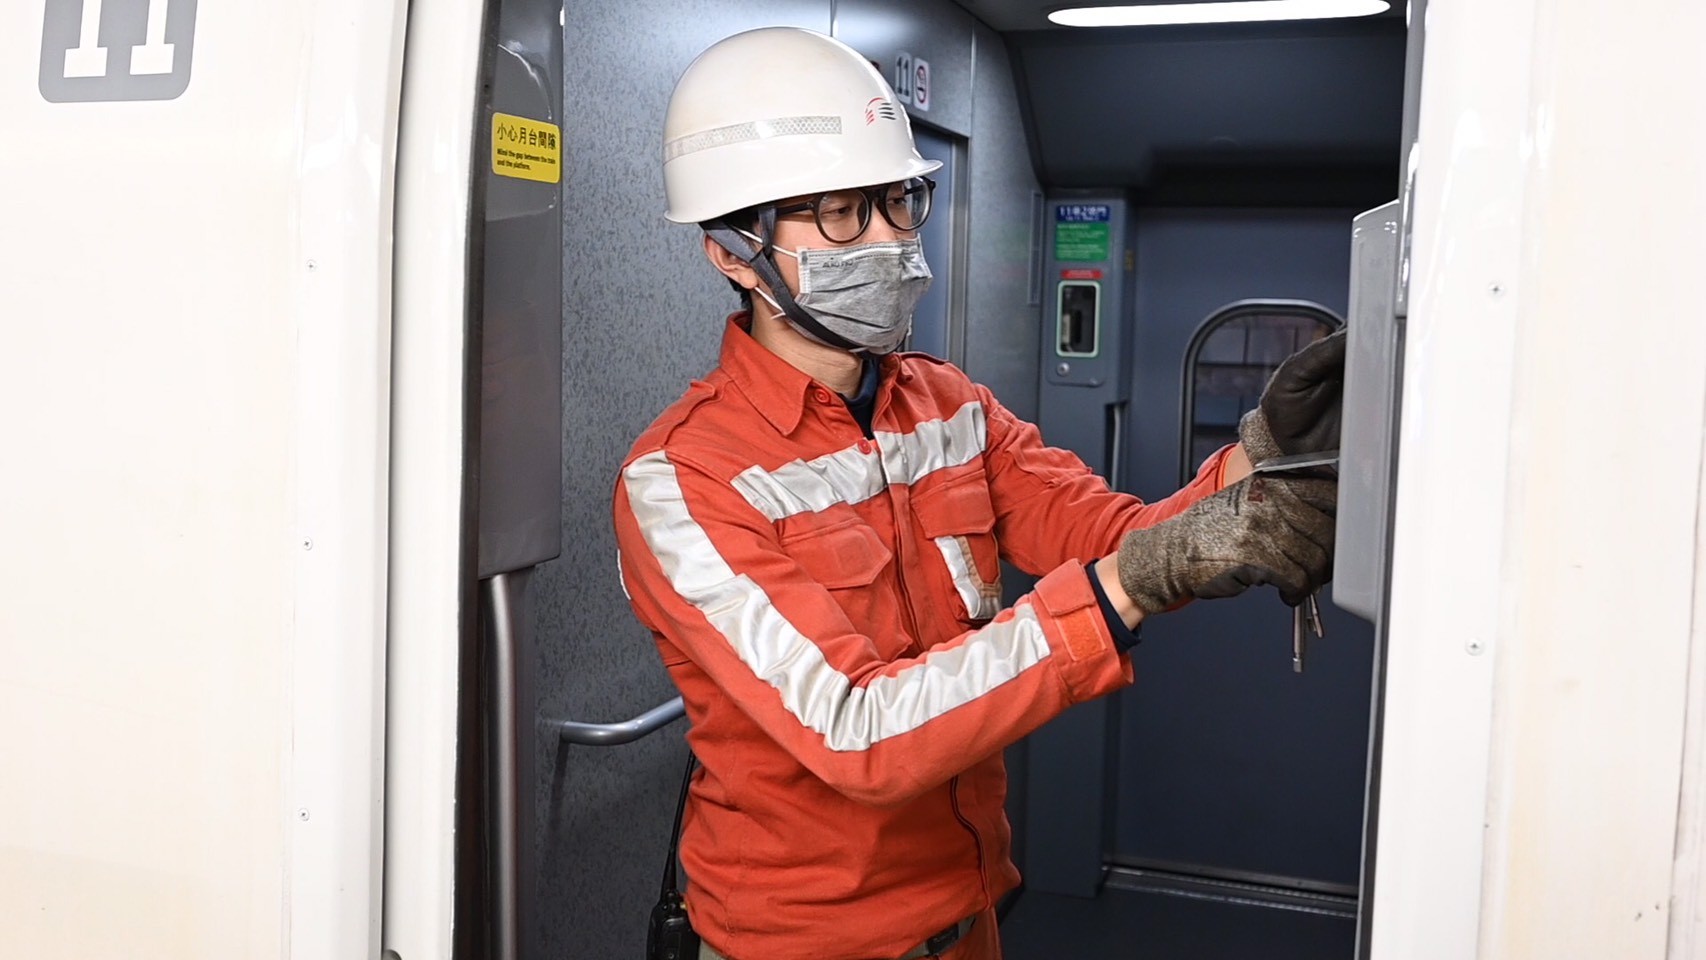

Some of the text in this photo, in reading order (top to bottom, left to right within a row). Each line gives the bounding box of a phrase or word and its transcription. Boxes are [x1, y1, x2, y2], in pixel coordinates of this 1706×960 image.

[497, 122, 557, 150] 小心月台間隙
